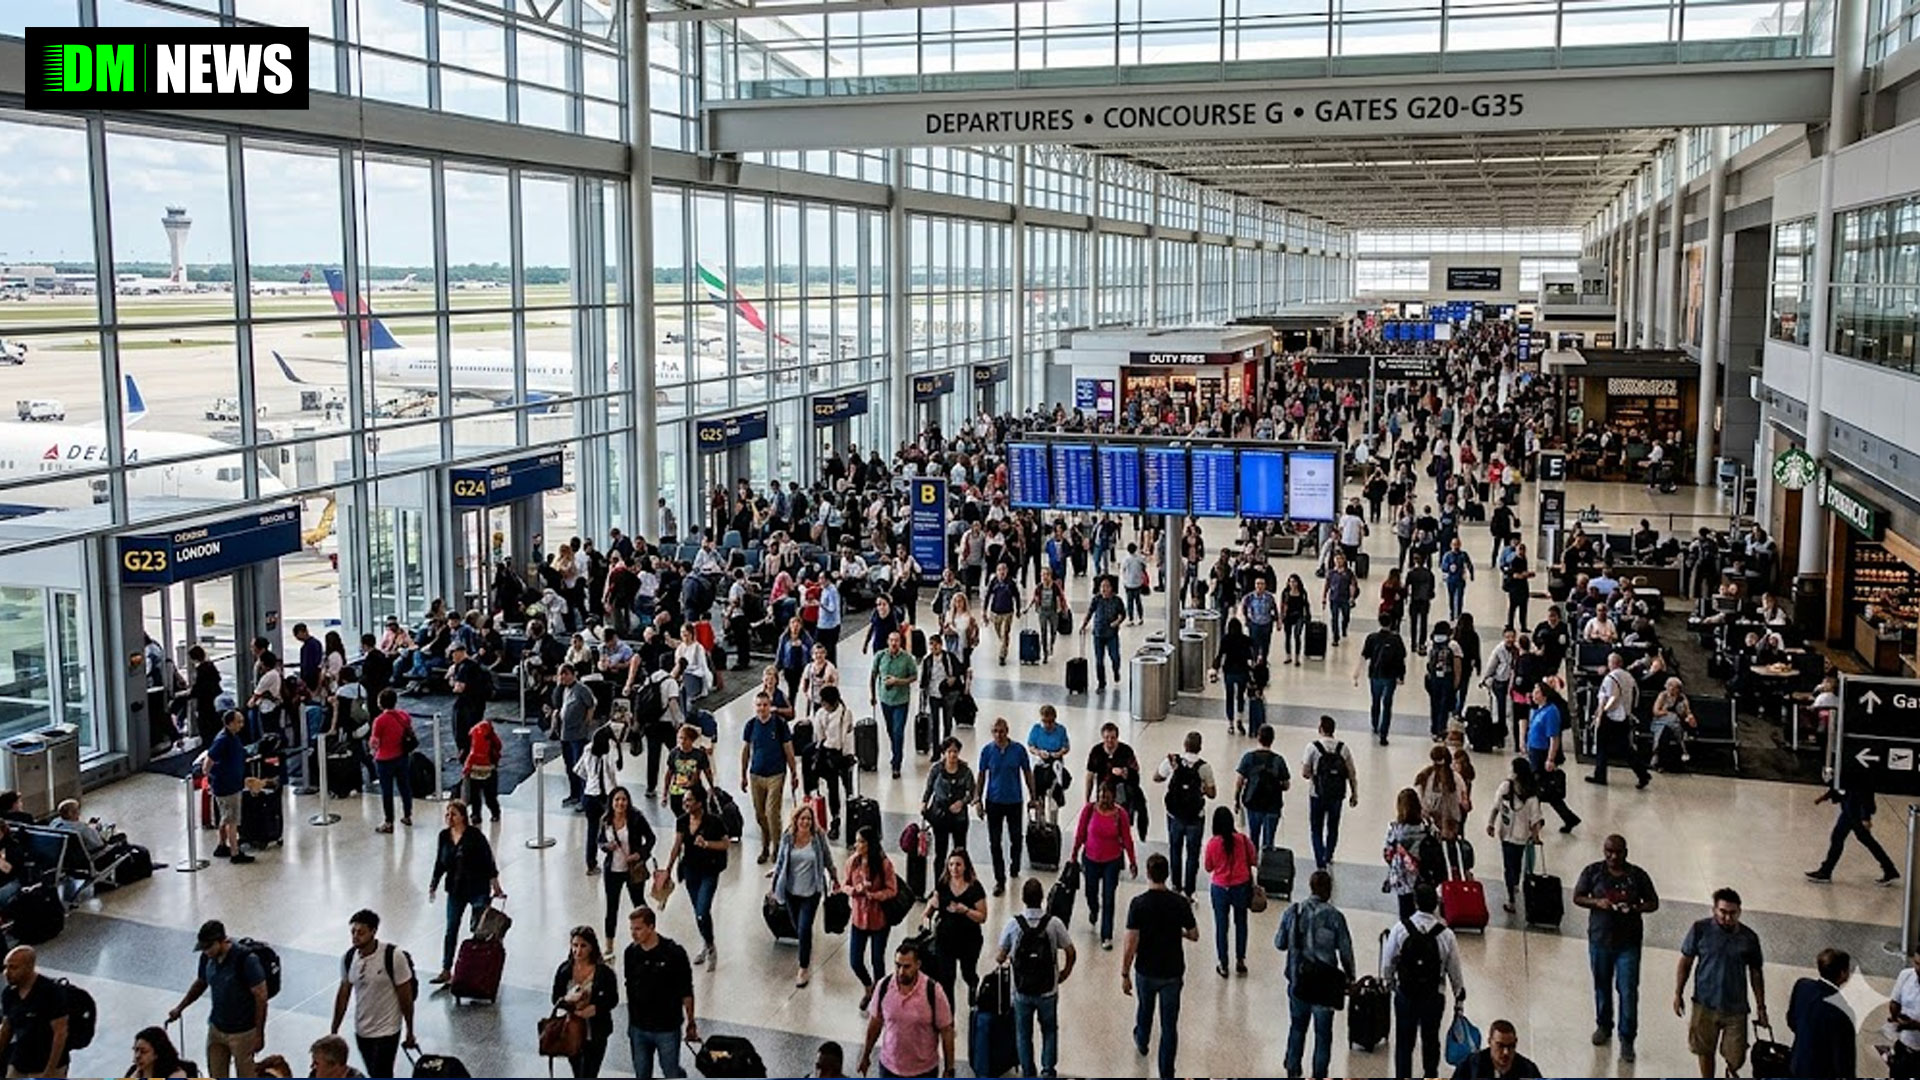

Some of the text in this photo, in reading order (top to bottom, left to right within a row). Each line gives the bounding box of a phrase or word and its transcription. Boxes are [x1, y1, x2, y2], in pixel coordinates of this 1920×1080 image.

[926, 94, 1523, 134] DEPARTURES CONCOURSE G GATES G20-G35
[67, 445, 138, 461] DELA
[454, 480, 486, 496] G24
[921, 484, 936, 504] B
[124, 550, 167, 571] G23
[176, 541, 221, 562] LONDON
[1893, 693, 1920, 708] Ga
